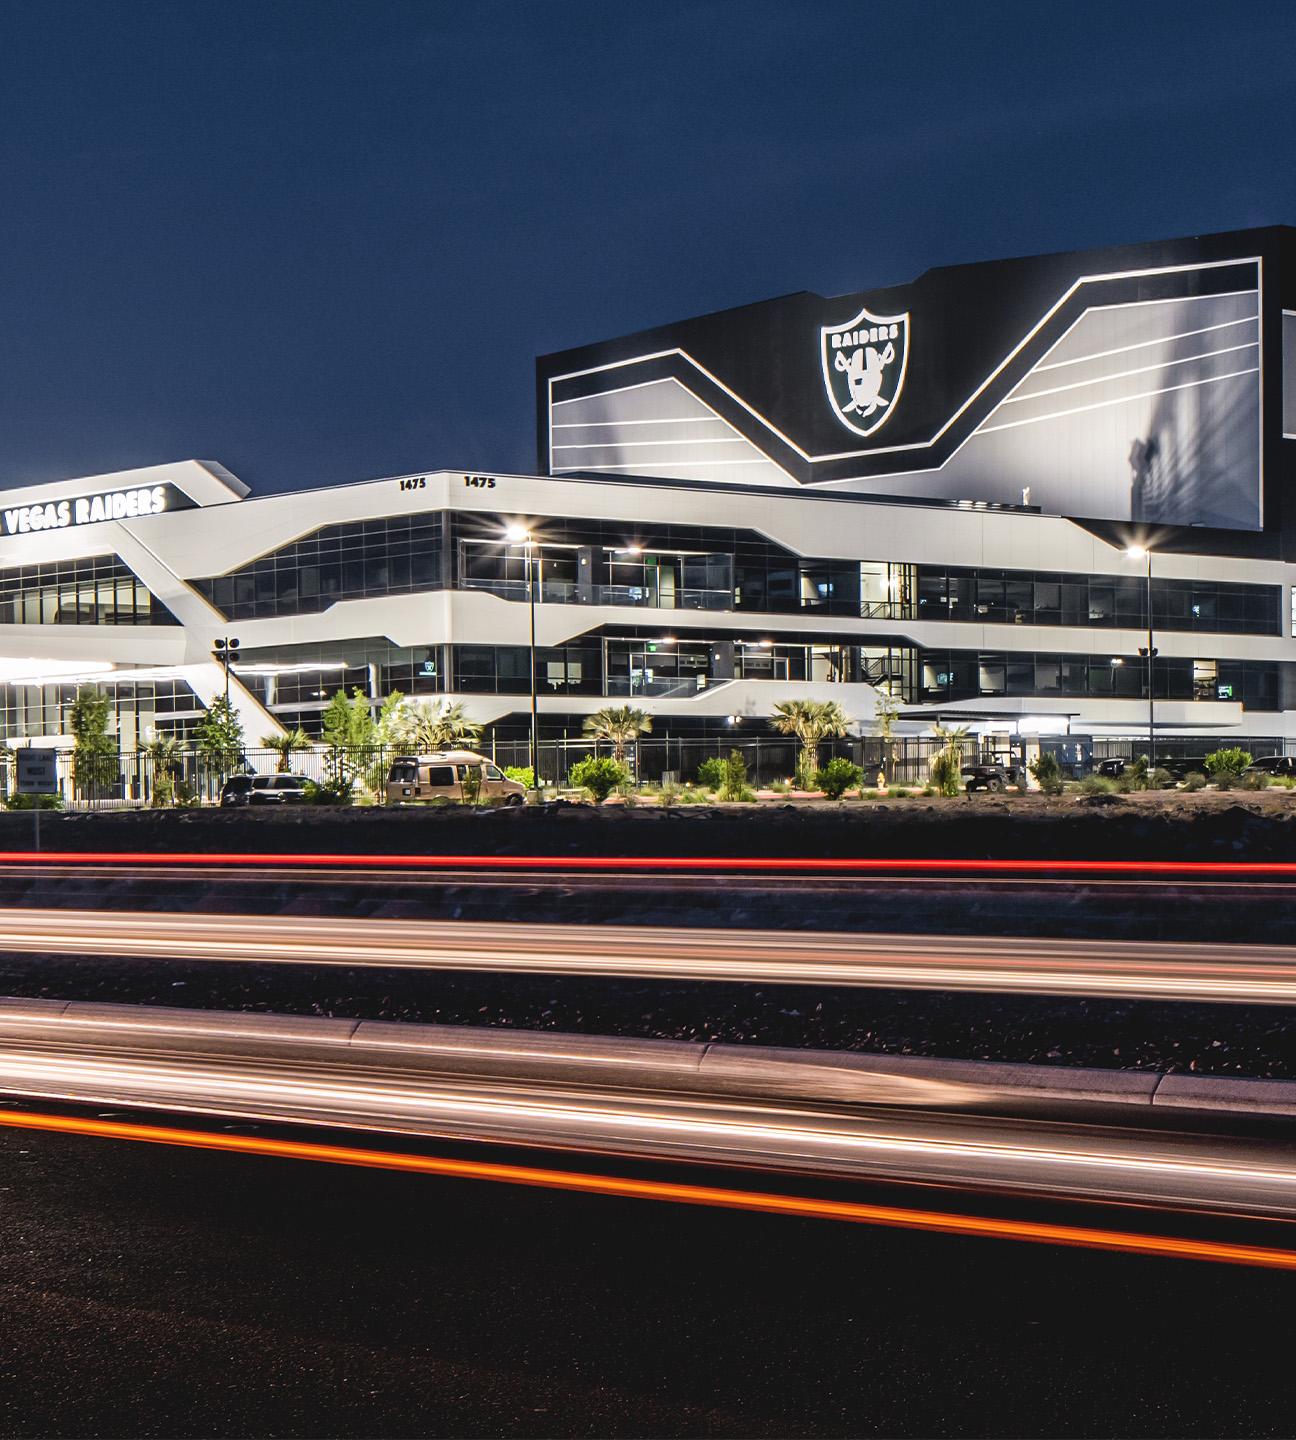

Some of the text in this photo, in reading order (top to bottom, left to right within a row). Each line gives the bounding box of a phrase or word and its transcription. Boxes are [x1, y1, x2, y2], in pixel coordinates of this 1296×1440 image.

[832, 324, 899, 349] RAIDERS
[400, 478, 426, 491] 1475
[464, 476, 496, 488] 1475
[5, 486, 165, 534] VEGAS RAIDERS
